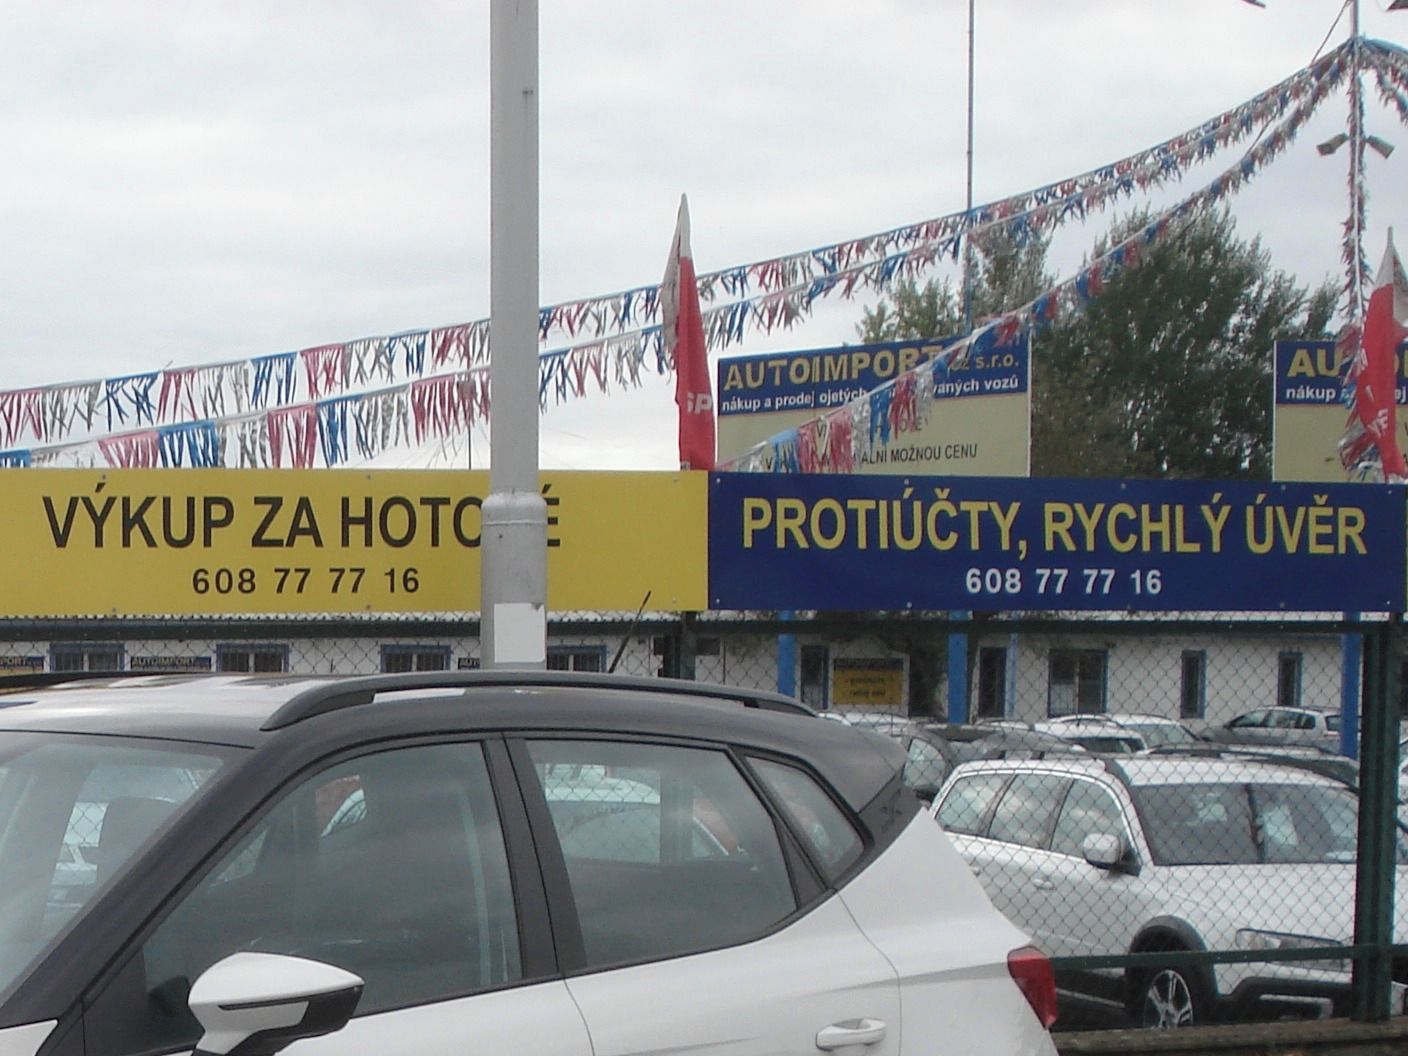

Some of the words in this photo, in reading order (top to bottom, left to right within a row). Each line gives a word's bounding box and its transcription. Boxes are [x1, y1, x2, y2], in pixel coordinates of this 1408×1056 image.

[976, 353, 1019, 369] s.r.o.
[722, 392, 760, 412] nákup
[764, 397, 772, 408] a
[775, 391, 815, 411] prodej
[984, 374, 1019, 390] vozů
[1286, 385, 1336, 402] nákup
[891, 443, 941, 463] MOŽNOU
[945, 444, 978, 460] CENU
[42, 482, 235, 548] VÝKUP
[251, 496, 324, 548] ZA
[340, 484, 560, 548] HOTOÉ
[743, 487, 1027, 560] PROTIÚČTY,
[1044, 492, 1232, 553] RYCHLÝ
[1246, 493, 1368, 554] ÚVĚR
[192, 567, 256, 594] 608
[274, 567, 311, 594] 77
[329, 567, 366, 594] 77
[384, 567, 419, 594] 16
[965, 567, 1022, 594] 608
[1035, 568, 1069, 594] 77
[1083, 568, 1116, 594] 77
[1131, 568, 1162, 595] 16
